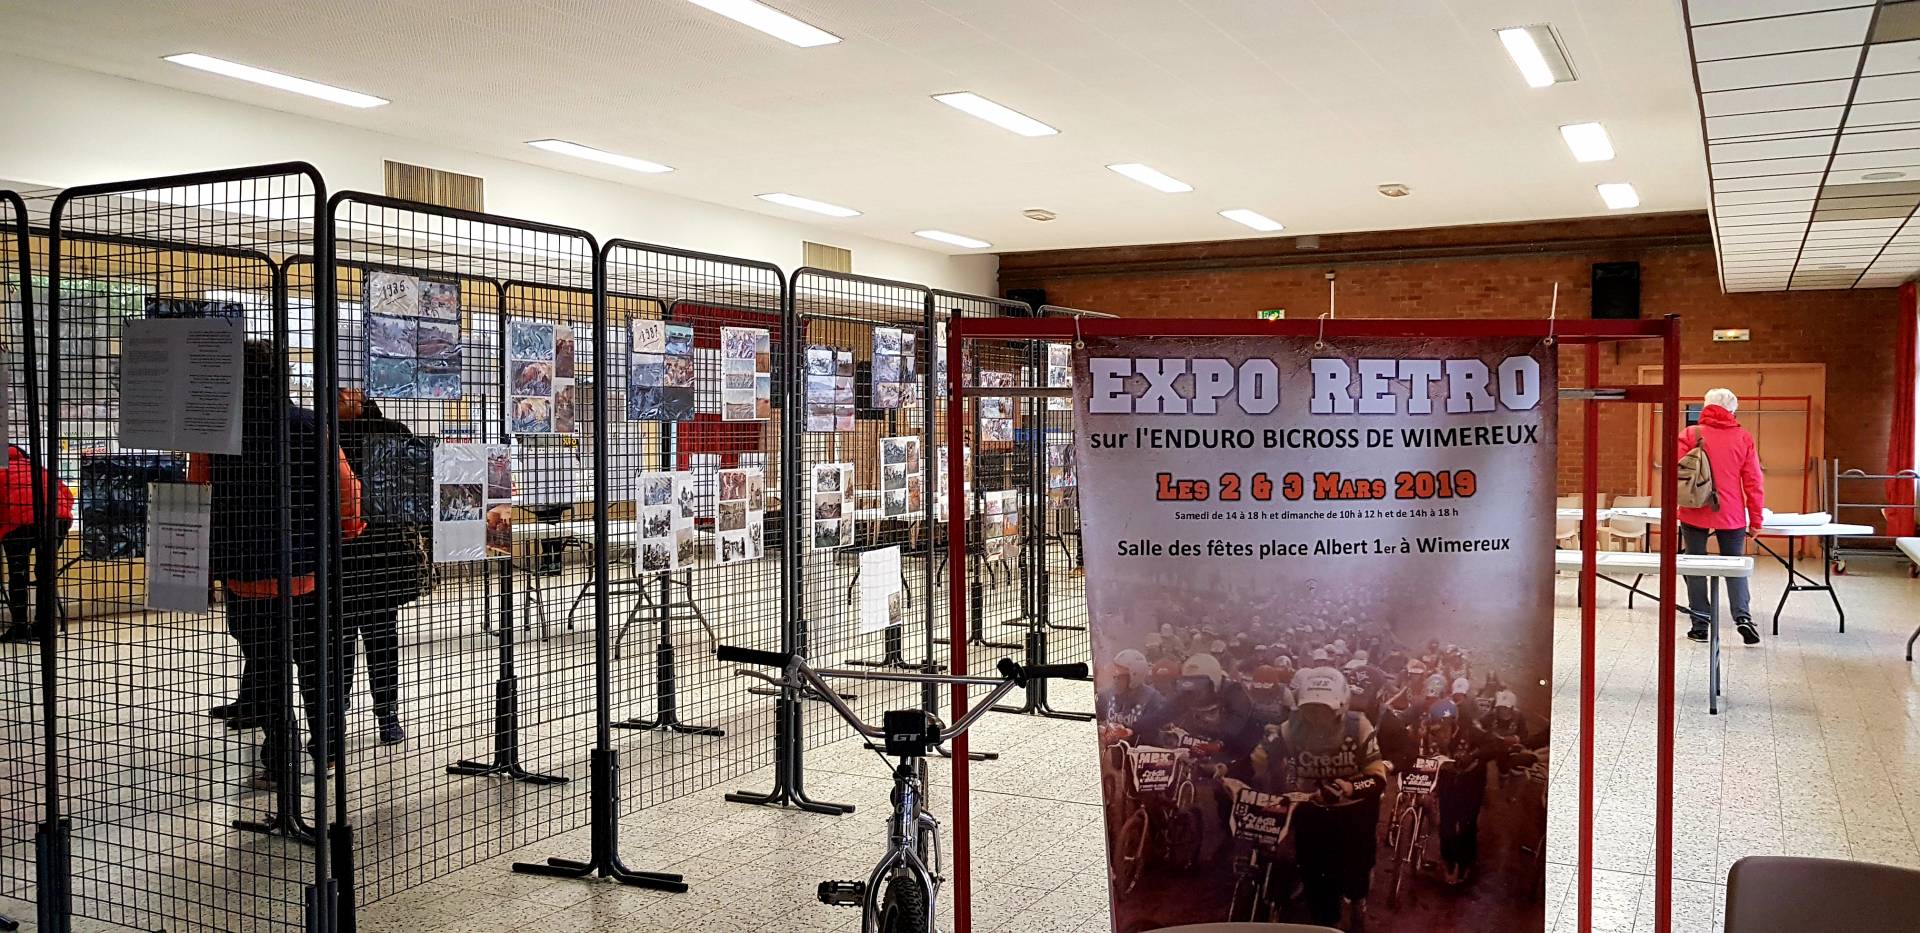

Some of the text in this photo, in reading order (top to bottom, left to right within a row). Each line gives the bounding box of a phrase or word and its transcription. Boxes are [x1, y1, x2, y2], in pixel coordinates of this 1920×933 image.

[1089, 356, 1540, 414] EXPO RETRO
[1090, 425, 1538, 449] sur l'ENDURO BICROSS DE WIMEREUX
[1219, 472, 1241, 501] 2
[1251, 472, 1273, 501] &
[1282, 472, 1304, 501] 3
[1395, 470, 1477, 499] 2019
[1175, 508, 1459, 520] Samedi de 14 à 18 h et dimanche de 10h à 12 h et de 14h à 18 h
[1117, 537, 1510, 560] Salle des fêtes place Albert 1er à Wimereux
[893, 733, 920, 741] GT
